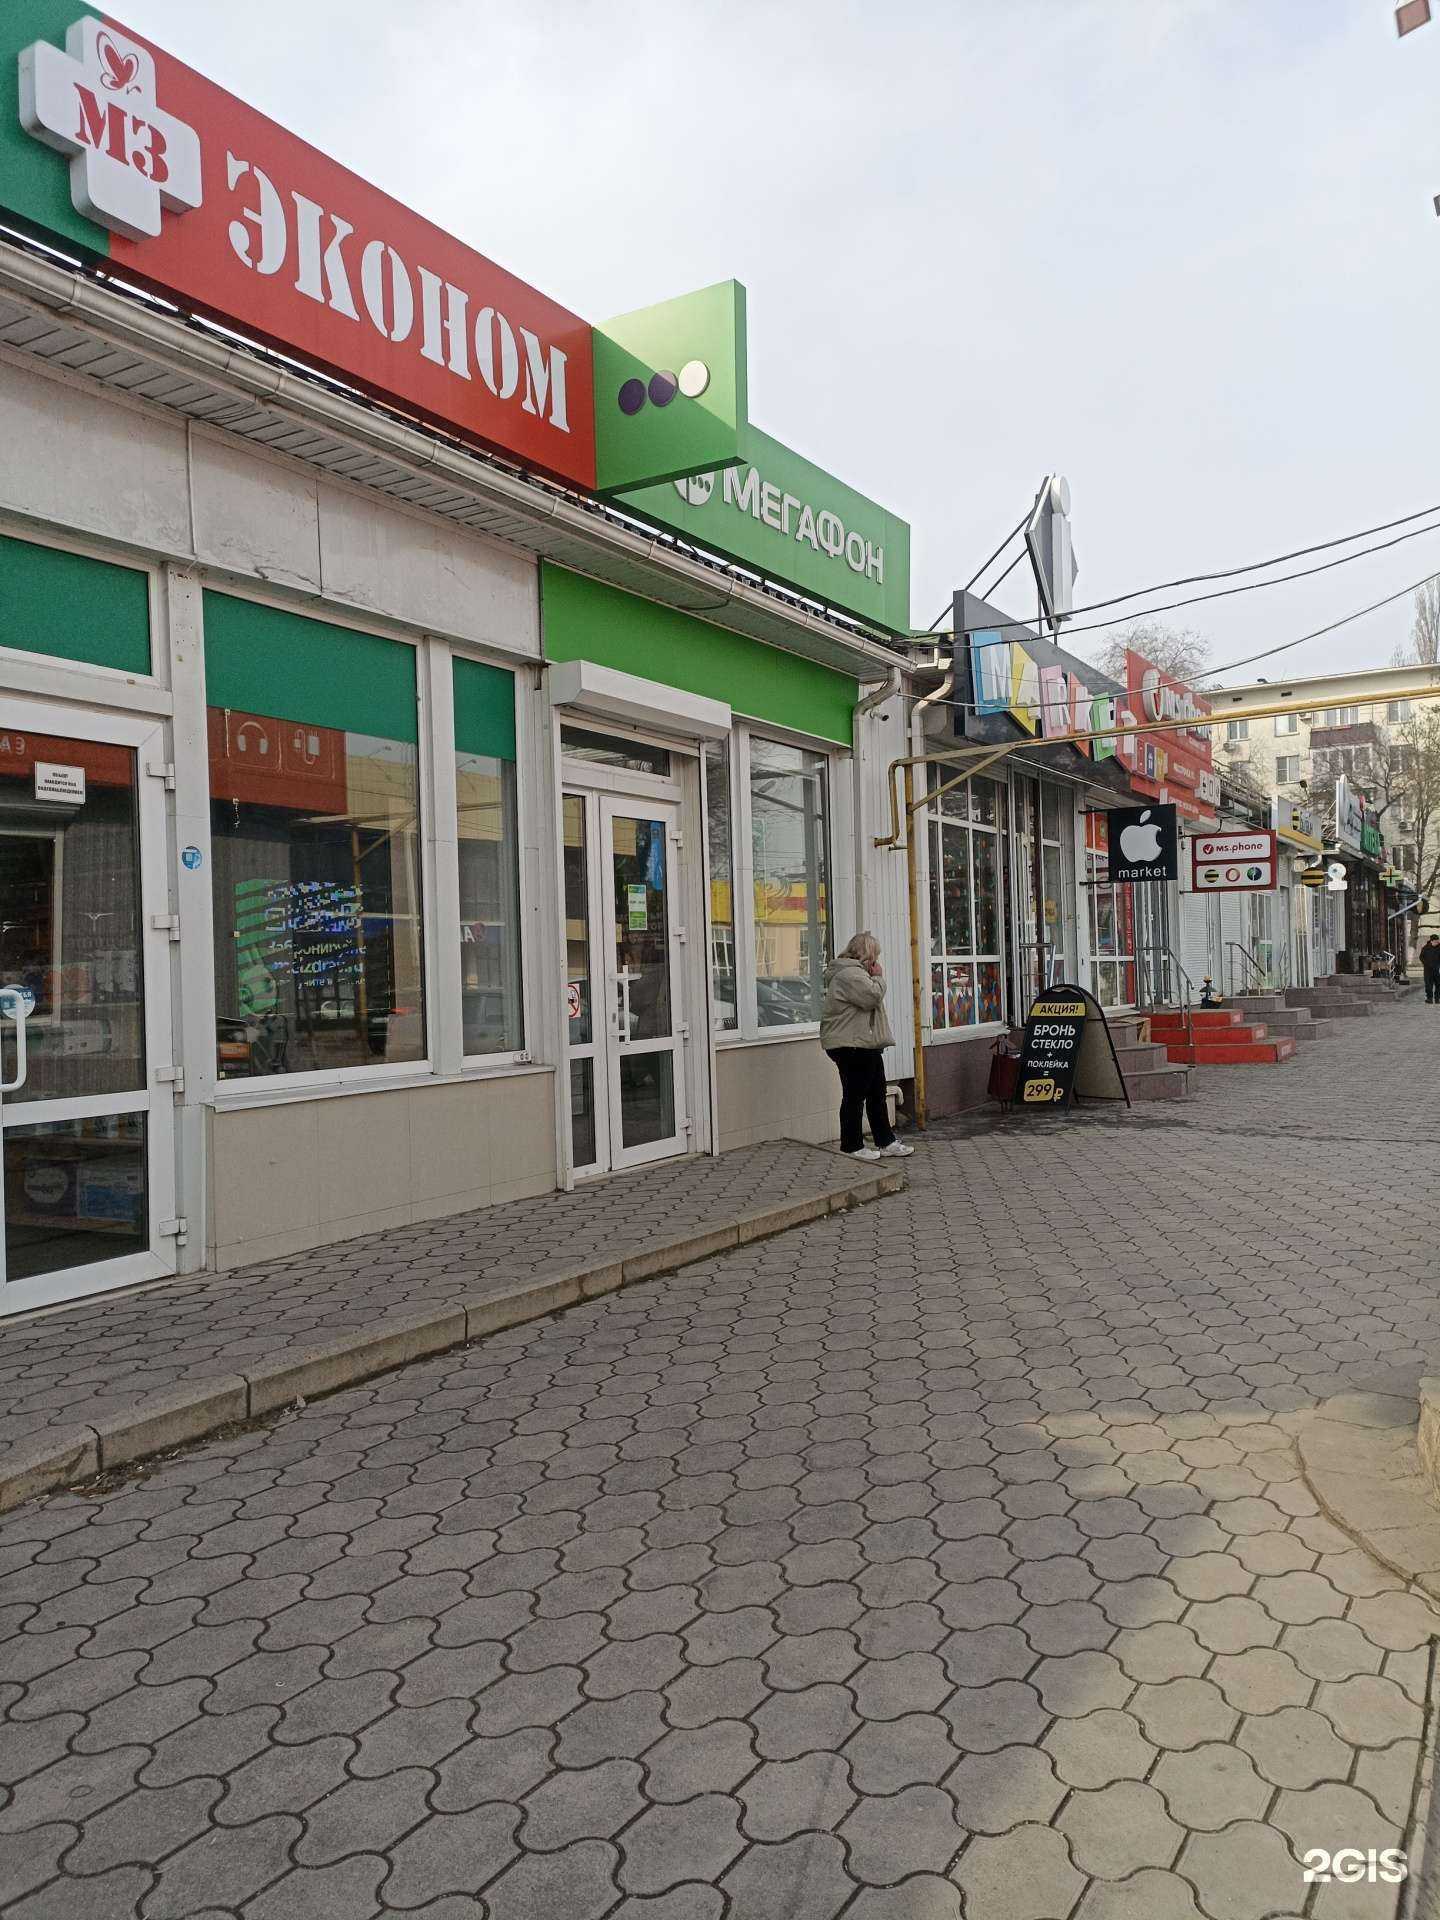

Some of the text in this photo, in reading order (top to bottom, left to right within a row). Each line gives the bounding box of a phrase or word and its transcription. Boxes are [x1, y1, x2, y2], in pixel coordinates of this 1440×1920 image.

[73, 82, 169, 183] МЗ
[226, 150, 570, 434] ЭКОНОМ
[723, 466, 884, 584] МЕГАФОН
[1118, 865, 1167, 879] market
[1039, 1004, 1079, 1015] АКЦИЯ!
[1033, 1024, 1076, 1036] БРОНЬ
[1031, 1039, 1073, 1049] СТЕКЛО
[1027, 1060, 1069, 1069] ПОКЛЕЙКА
